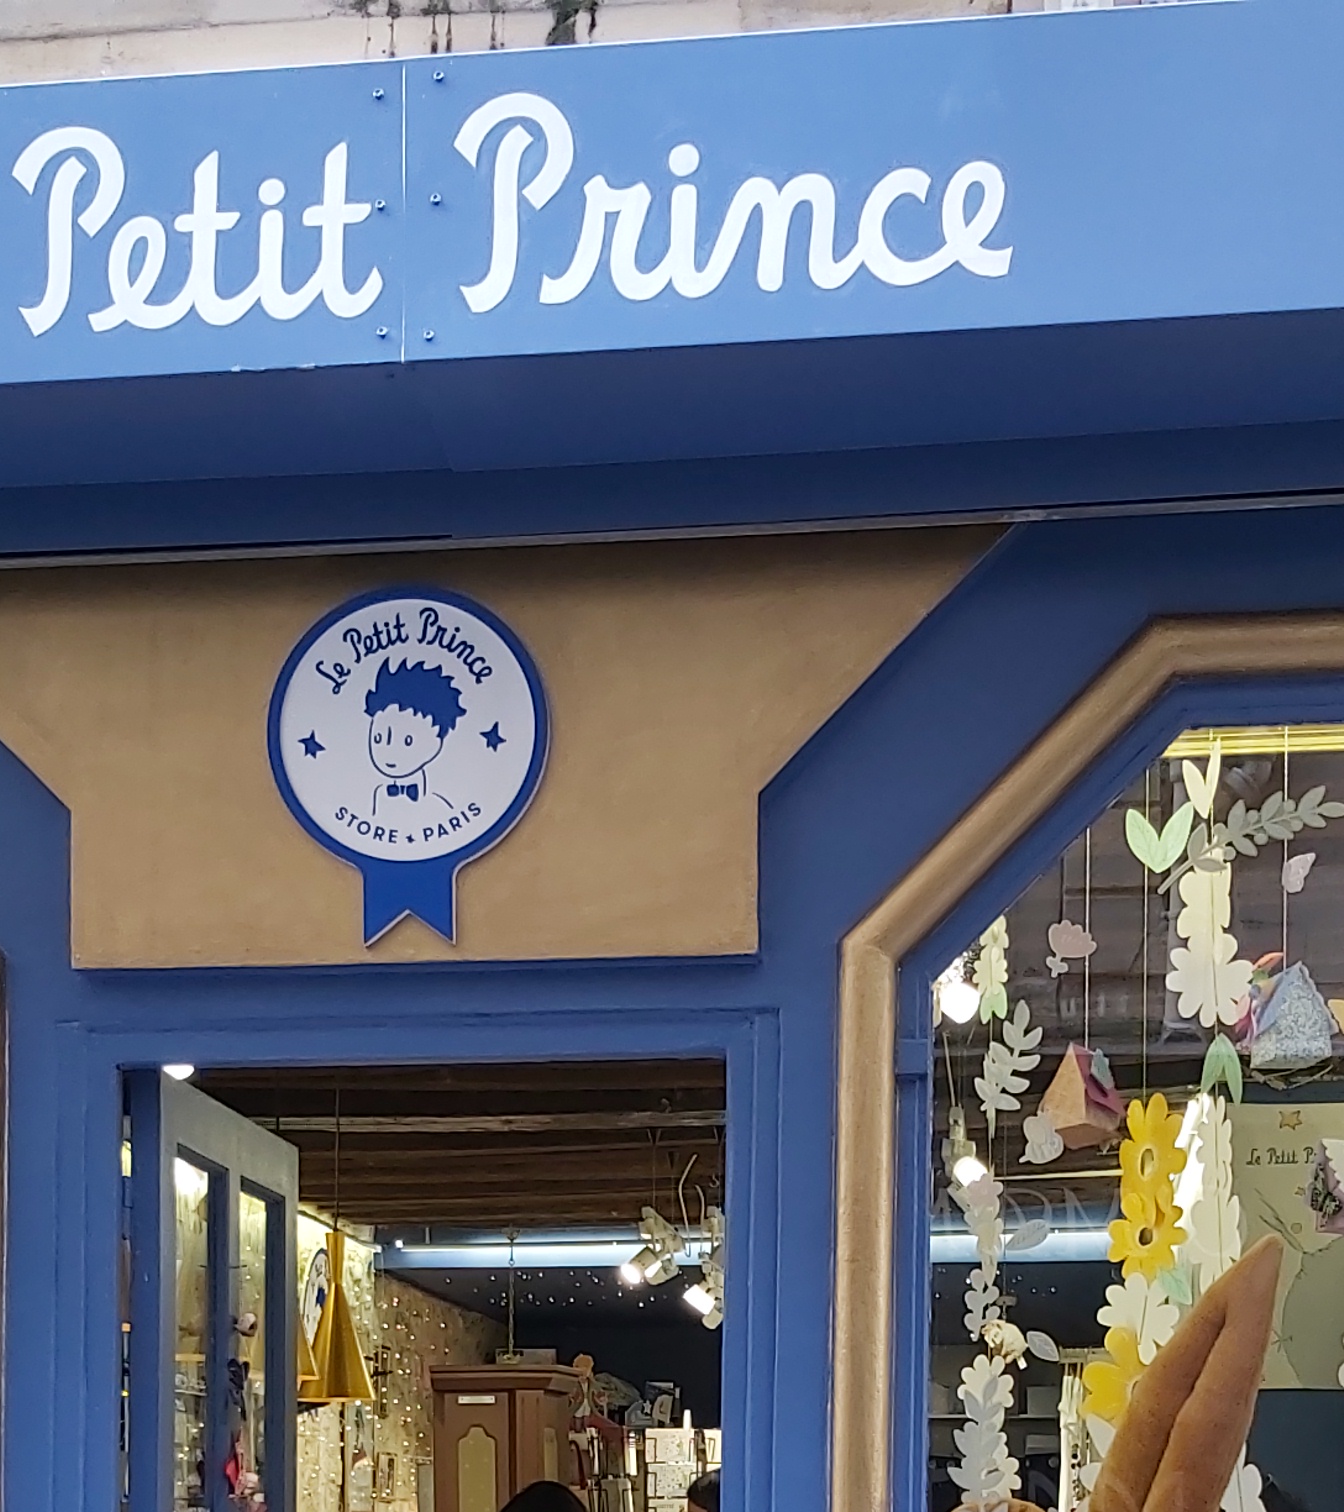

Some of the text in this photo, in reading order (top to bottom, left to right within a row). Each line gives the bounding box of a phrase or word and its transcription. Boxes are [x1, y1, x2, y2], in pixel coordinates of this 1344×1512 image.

[10, 123, 384, 340] Petit
[453, 91, 1015, 316] Prince
[315, 606, 493, 695] Le Petit Prince
[334, 801, 483, 845] STORE PARIS
[1246, 1148, 1261, 1166] Le
[1266, 1146, 1300, 1166] Petit
